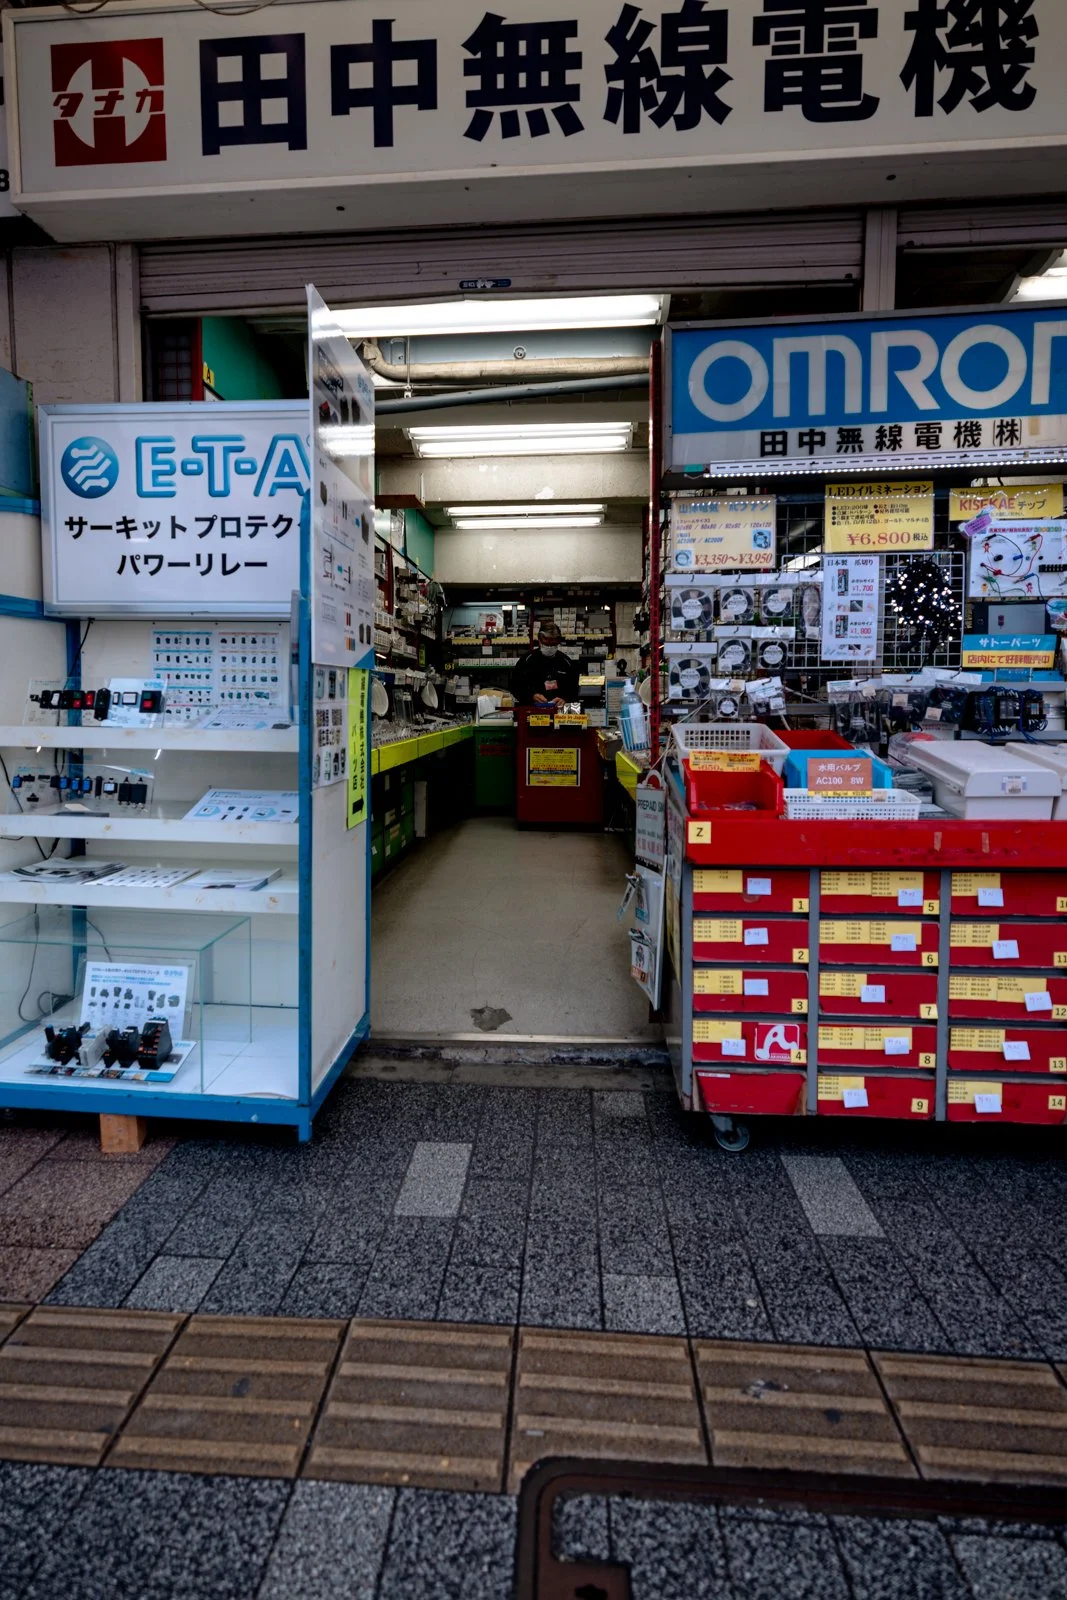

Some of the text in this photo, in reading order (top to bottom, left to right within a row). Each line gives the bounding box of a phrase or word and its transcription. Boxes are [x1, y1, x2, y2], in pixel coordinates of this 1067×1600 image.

[199, 0, 1039, 156] 田中無線電機
[52, 89, 165, 118] タナカ
[828, 485, 931, 497] LEDイルミネーション
[64, 514, 301, 540] サーキットプロテク
[847, 532, 911, 545] ¥6,800
[117, 553, 268, 577] パワーリレー
[978, 637, 1041, 648] サトーパーツ
[816, 776, 865, 785] AC100 8W
[696, 827, 704, 838] Z
[798, 900, 804, 910] 1
[928, 902, 935, 912] 5
[798, 950, 804, 960] 2
[926, 954, 934, 964] 6
[797, 1001, 803, 1010] 3
[925, 1006, 932, 1016] 7
[1055, 1008, 1067, 1016] 12
[795, 1051, 802, 1060] 4
[924, 1055, 931, 1064] 8
[1052, 1060, 1064, 1069] 13
[916, 1101, 924, 1110] 9
[1051, 1098, 1063, 1107] 14
